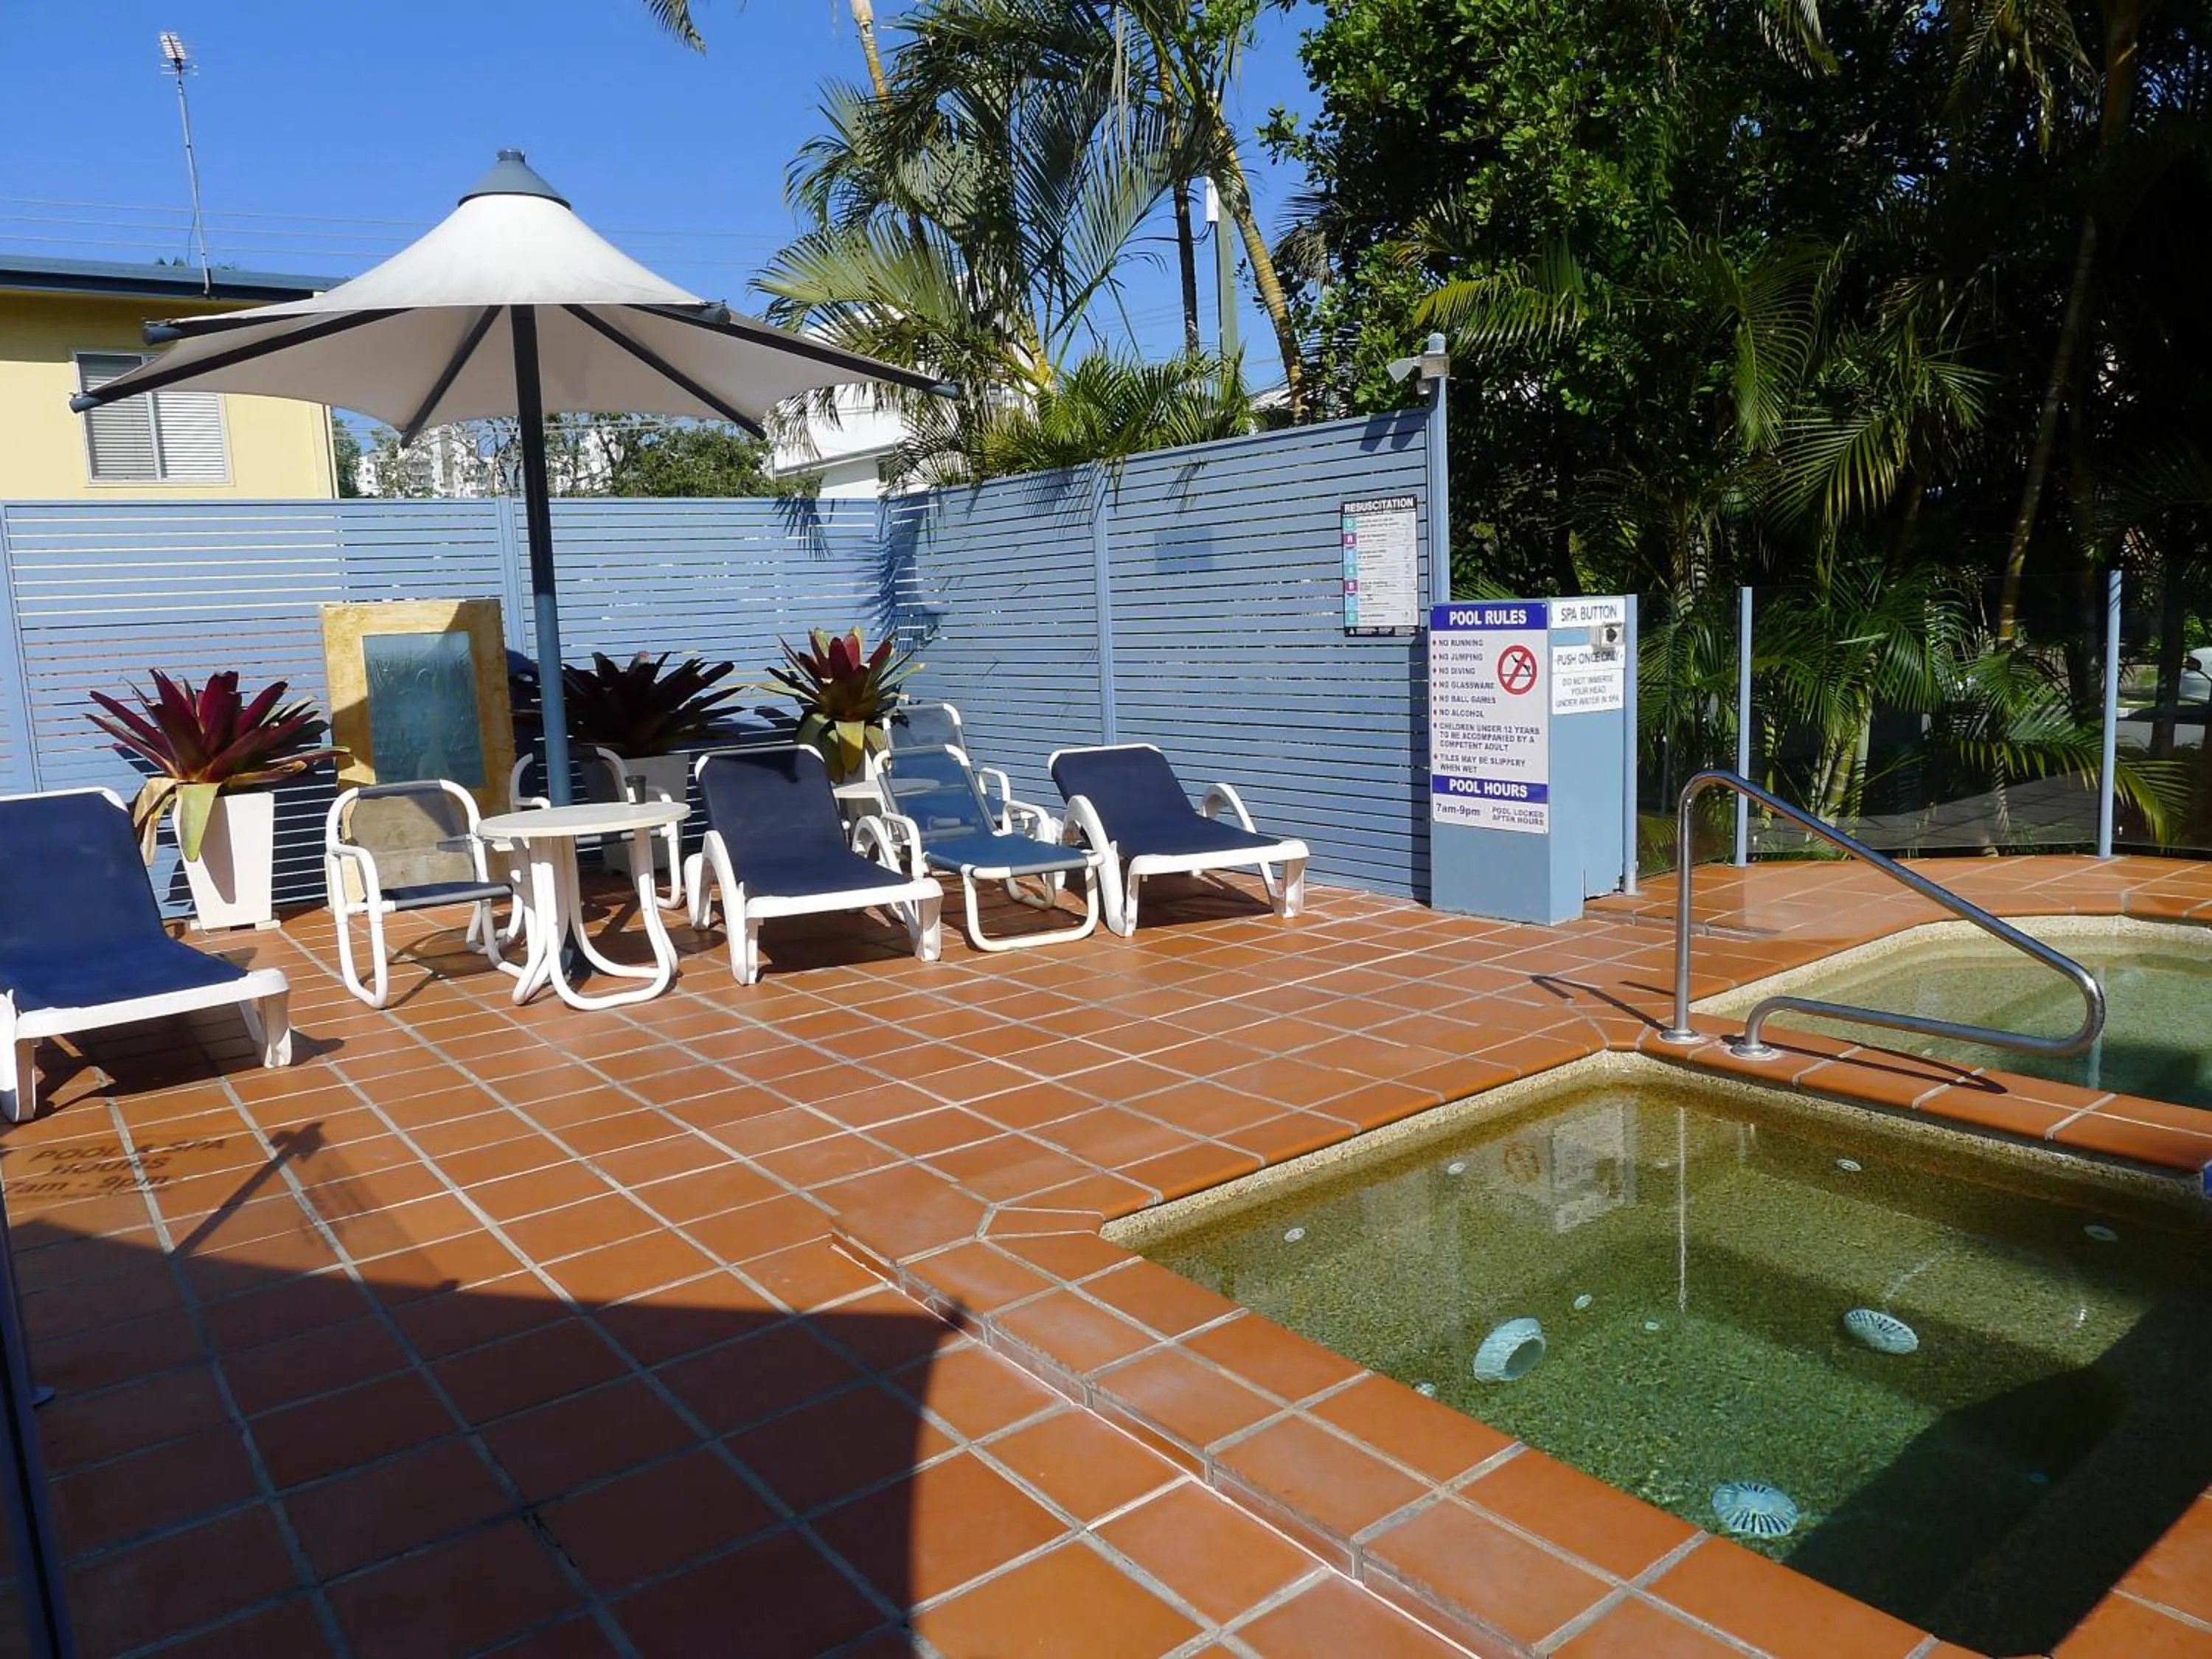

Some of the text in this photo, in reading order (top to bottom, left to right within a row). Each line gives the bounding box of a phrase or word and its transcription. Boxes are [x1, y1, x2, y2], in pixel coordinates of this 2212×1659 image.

[1344, 497, 1413, 513] RESUSCITATION
[1450, 610, 1527, 626] POOL RULES
[1561, 605, 1616, 621] SPA BUTTON
[1557, 654, 1577, 666] PUSH
[1579, 652, 1599, 664] ONCE
[1573, 676, 1587, 684] NOT
[1571, 686, 1606, 695] YOUR HEAD
[1472, 696, 1496, 704] GAMES
[1451, 709, 1484, 717] ALCOHOL
[1439, 723, 1475, 731] CHILDREN
[1477, 724, 1502, 732] UNDER
[1514, 726, 1540, 734] YEARS
[1462, 733, 1514, 742] ACCOMPANIED
[1439, 740, 1509, 751] COMPETENT ADULT
[1440, 754, 1458, 762] TILES
[1490, 757, 1526, 767] SLIPPERY
[1441, 764, 1477, 773] WHEN WET
[1450, 779, 1528, 798] POOL HOURS
[1436, 802, 1481, 817] 7am-9pm
[1514, 808, 1544, 817] LOCKED
[1492, 813, 1544, 826] AFTER HOURS
[29, 1146, 118, 1162] POOL
